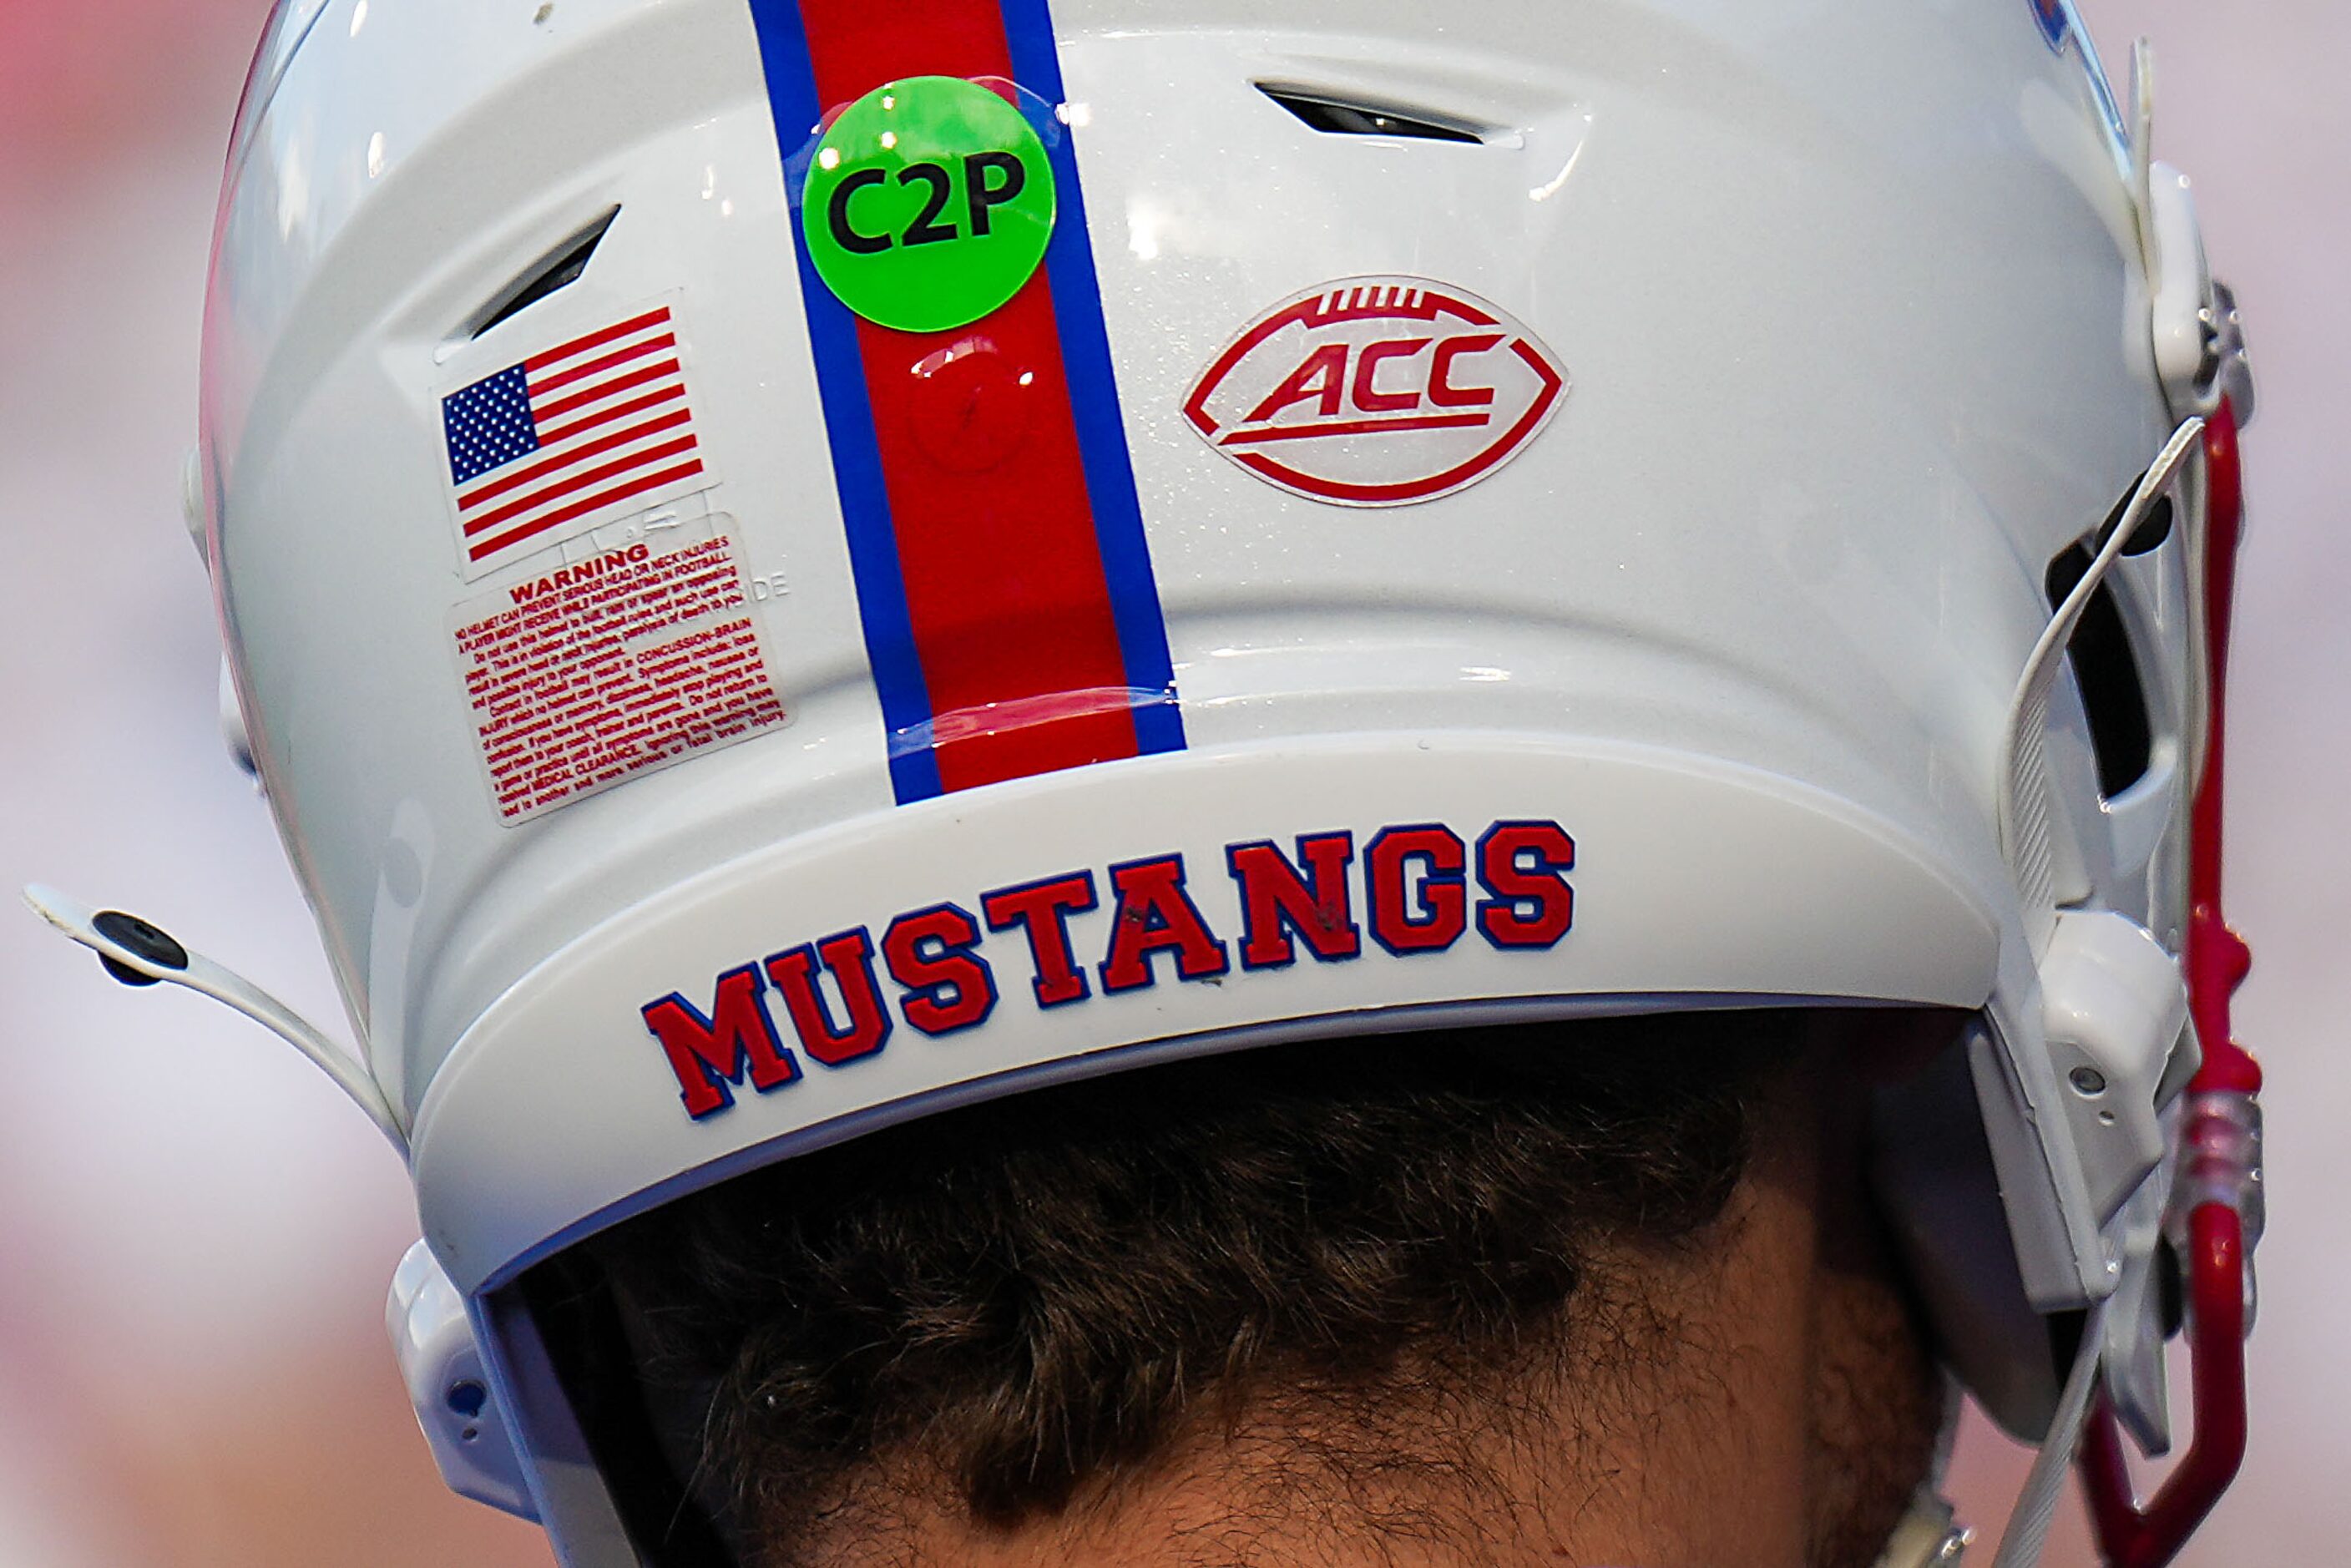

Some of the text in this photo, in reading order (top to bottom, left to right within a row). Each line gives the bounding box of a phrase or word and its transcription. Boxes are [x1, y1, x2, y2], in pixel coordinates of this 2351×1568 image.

[827, 151, 1025, 254] C2P
[1242, 334, 1507, 422] ACC
[512, 545, 647, 602] WARNING
[641, 819, 1575, 1122] MUSTANGS
